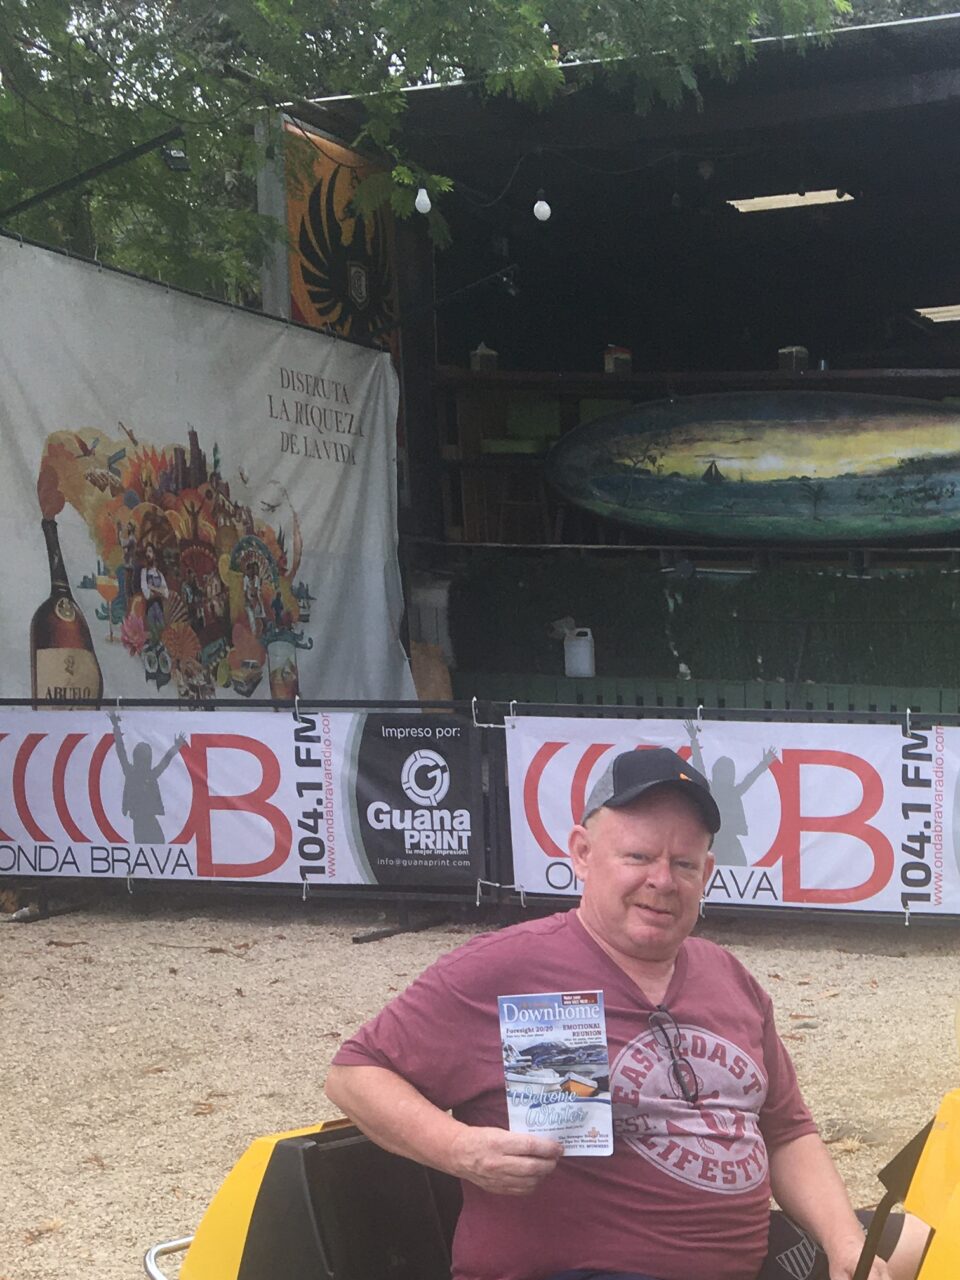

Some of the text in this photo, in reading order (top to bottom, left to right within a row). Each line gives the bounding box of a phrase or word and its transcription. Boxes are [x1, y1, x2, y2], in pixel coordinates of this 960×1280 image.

[280, 367, 350, 404] DISFRUTA
[267, 394, 290, 421] LA
[280, 431, 300, 455] DE
[382, 725, 461, 739] Impreso por:
[292, 711, 326, 882] 104.1 FM
[366, 801, 471, 830] Guana
[901, 727, 932, 910] 104.1 FM
[404, 830, 472, 850] PRINT
[0, 845, 193, 875] ONDA BRAVA
[704, 868, 778, 901] AVA
[503, 1003, 600, 1023] Downhome
[612, 1033, 762, 1109] EAST COAST
[511, 1085, 577, 1107] Welcome
[614, 1113, 657, 1135] EST.
[635, 1136, 766, 1184] LIFESTYL
